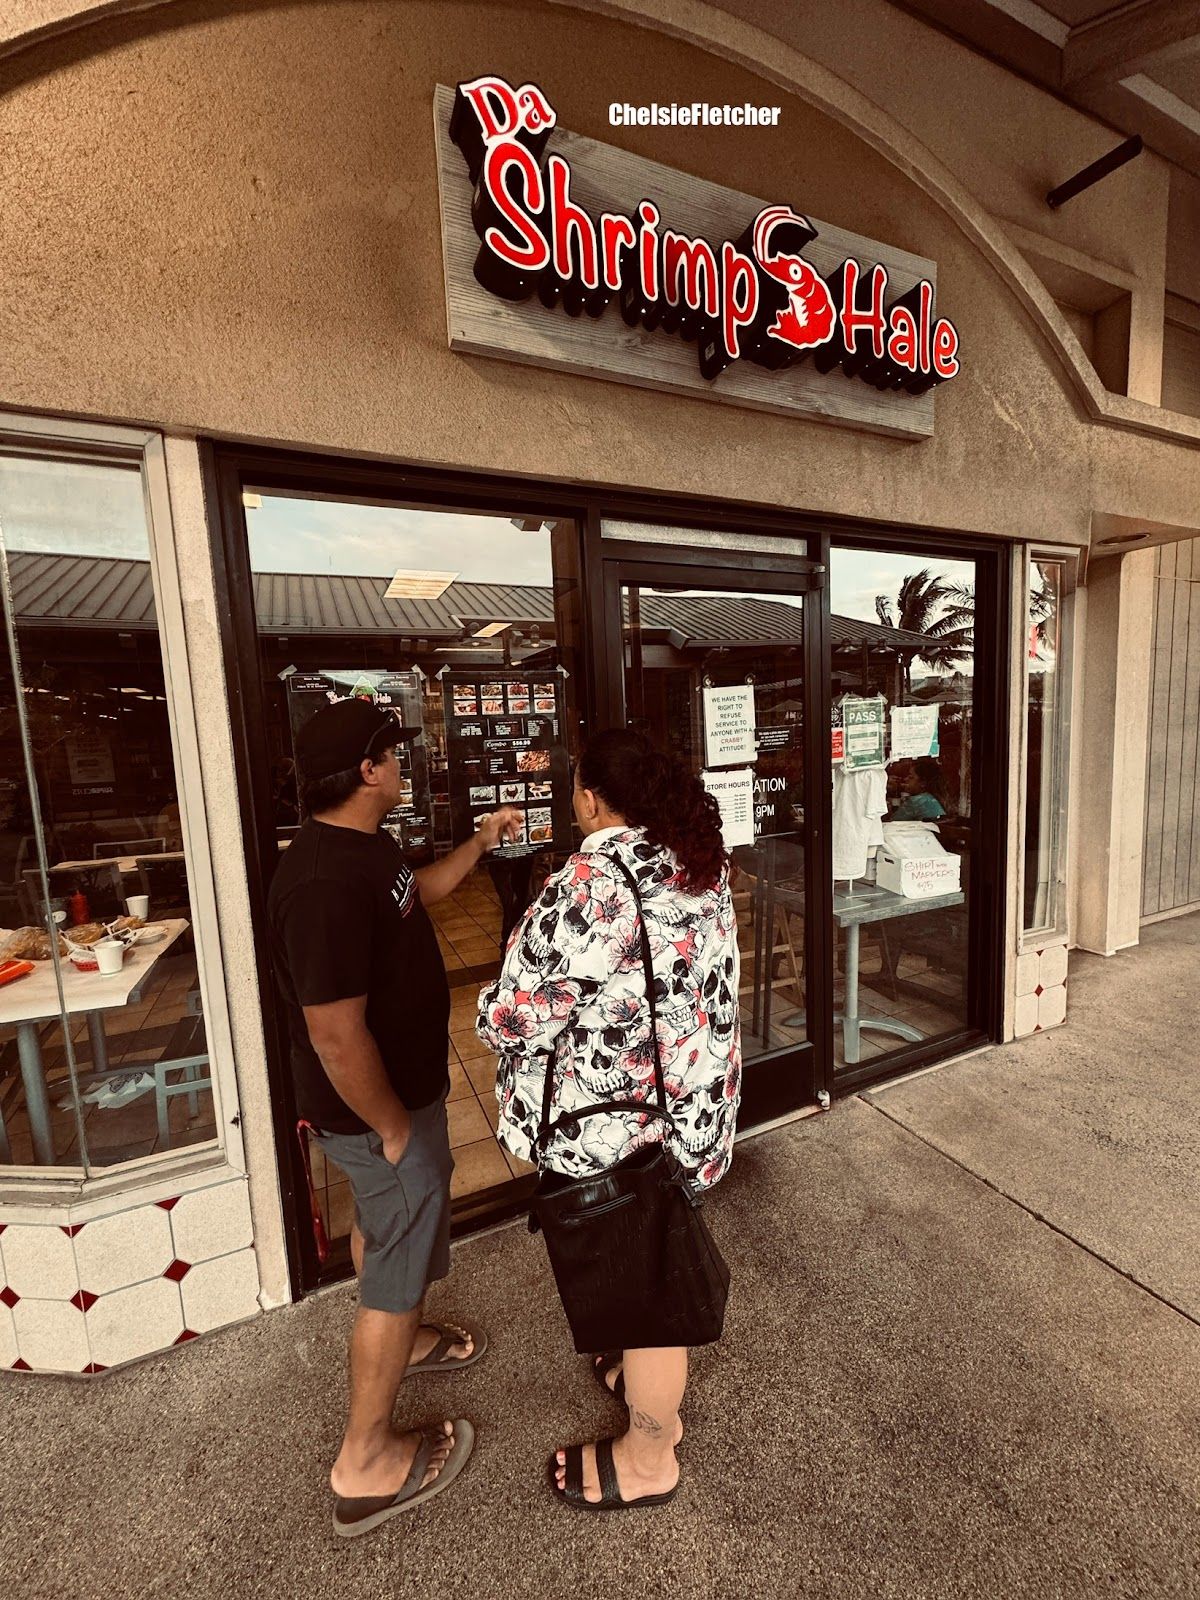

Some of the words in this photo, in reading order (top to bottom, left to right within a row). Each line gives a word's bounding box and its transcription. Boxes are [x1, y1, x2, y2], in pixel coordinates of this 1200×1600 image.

[460, 76, 556, 145] Da
[484, 142, 759, 359] Shrimp
[840, 257, 961, 379] Hale
[849, 711, 877, 723] PASS
[715, 720, 738, 728] SERVICE
[720, 736, 743, 744] CRABBY
[706, 783, 728, 791] STORE
[728, 781, 750, 789] HOURS
[753, 777, 786, 793] ATION
[755, 804, 775, 817] 9PM
[754, 822, 762, 834] M
[904, 859, 937, 872] SHIRT
[911, 869, 955, 881] MARKERS
